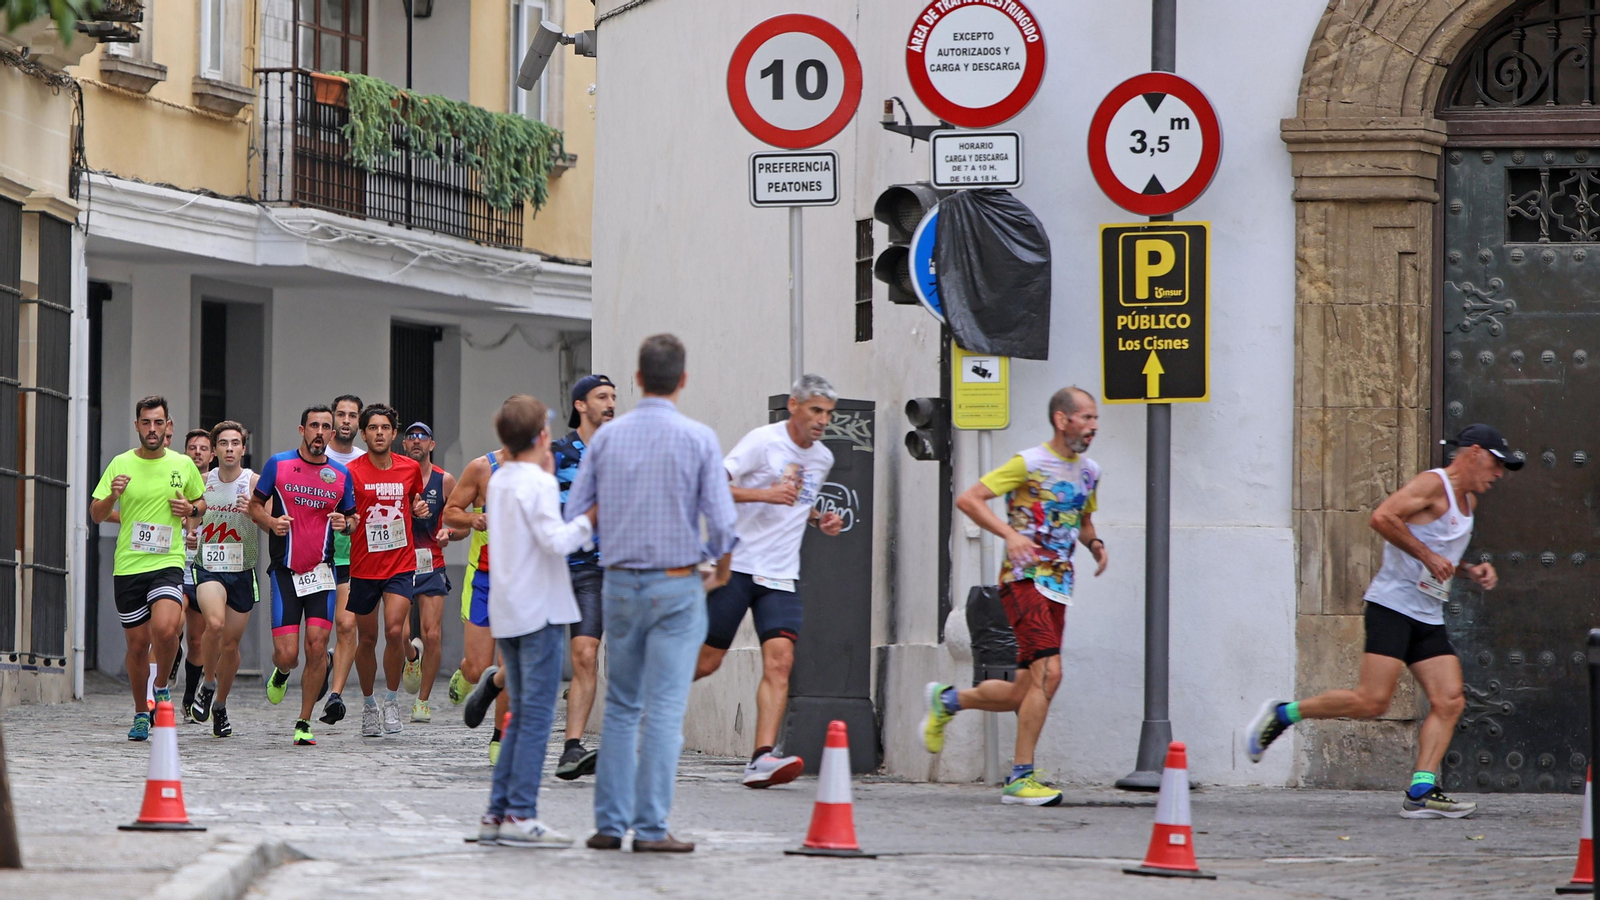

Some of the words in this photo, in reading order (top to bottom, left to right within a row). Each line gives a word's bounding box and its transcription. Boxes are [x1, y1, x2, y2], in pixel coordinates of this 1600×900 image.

[907, 24, 930, 53] ÁREA
[922, 8, 940, 26] DE
[953, 32, 994, 41] EXCEPTO
[937, 47, 1001, 57] AUTORIZADOS
[1004, 46, 1010, 55] Y
[929, 63, 961, 72] CARGA
[963, 63, 970, 71] Y
[972, 62, 1021, 71] DESCARGA
[760, 59, 828, 101] 10
[1170, 117, 1190, 130] m
[959, 142, 994, 150] HORARIO
[1129, 129, 1170, 157] 3,5
[945, 154, 967, 163] CARGA
[974, 153, 1009, 162] DESCARGA
[758, 161, 831, 173] PREFERENCIA
[767, 181, 822, 193] PEATONES
[1135, 239, 1176, 299] P
[1117, 310, 1191, 330] PÚBLICO
[1118, 337, 1141, 351] Los
[1143, 335, 1189, 350] Cisnes
[284, 483, 337, 499] GADEIRAS
[294, 496, 327, 509] SPORT
[139, 530, 151, 541] 99
[371, 530, 389, 541] 718
[206, 551, 225, 561] 520
[298, 573, 317, 586] 462
